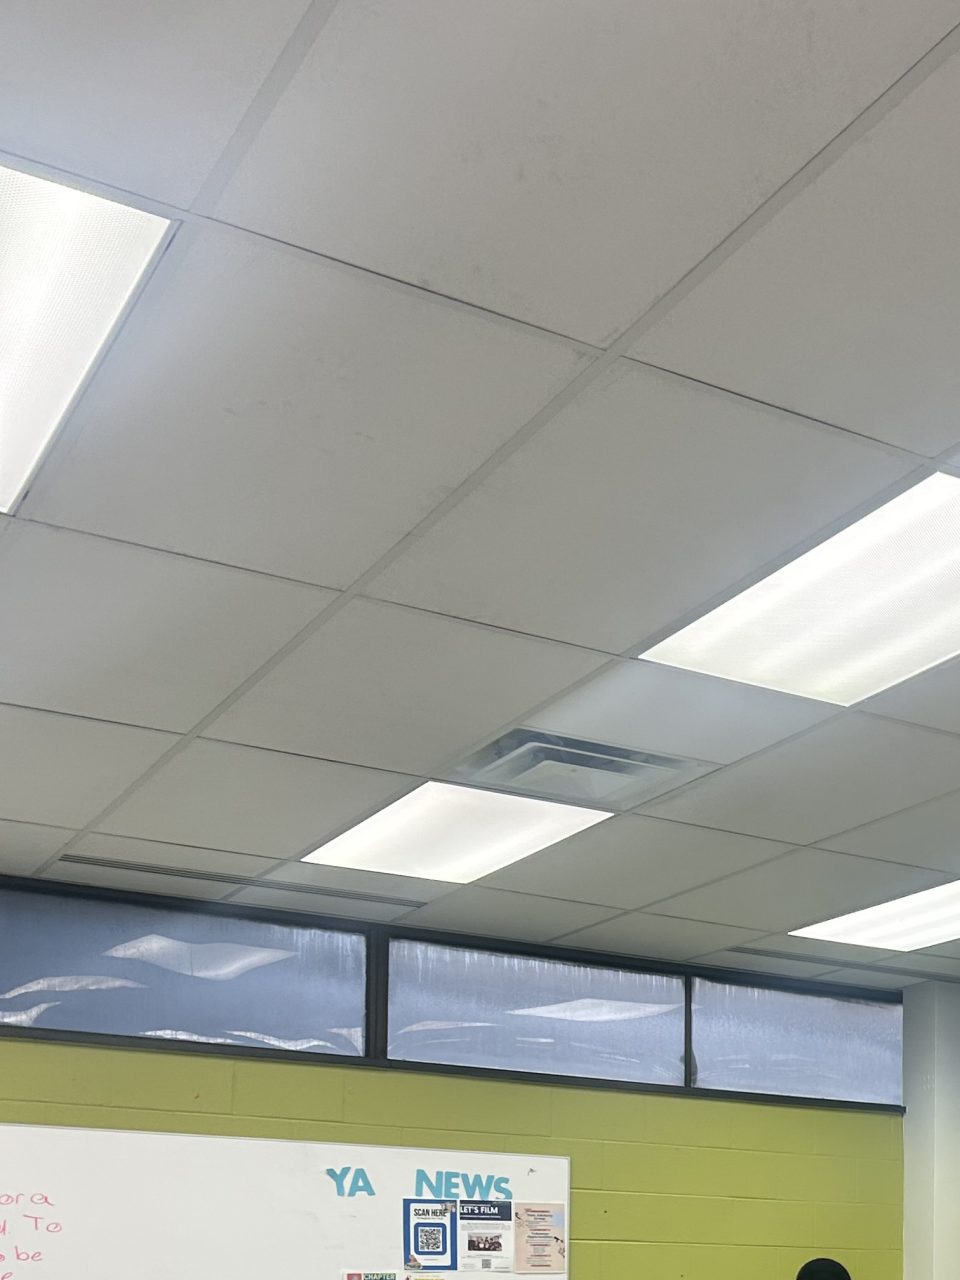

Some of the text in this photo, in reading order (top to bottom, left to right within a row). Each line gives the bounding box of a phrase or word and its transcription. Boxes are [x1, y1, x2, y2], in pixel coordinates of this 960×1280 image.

[326, 1166, 512, 1201] YA NEWS
[414, 1208, 447, 1217] SCAN HERE
[460, 1205, 499, 1214] LET'S FILM
